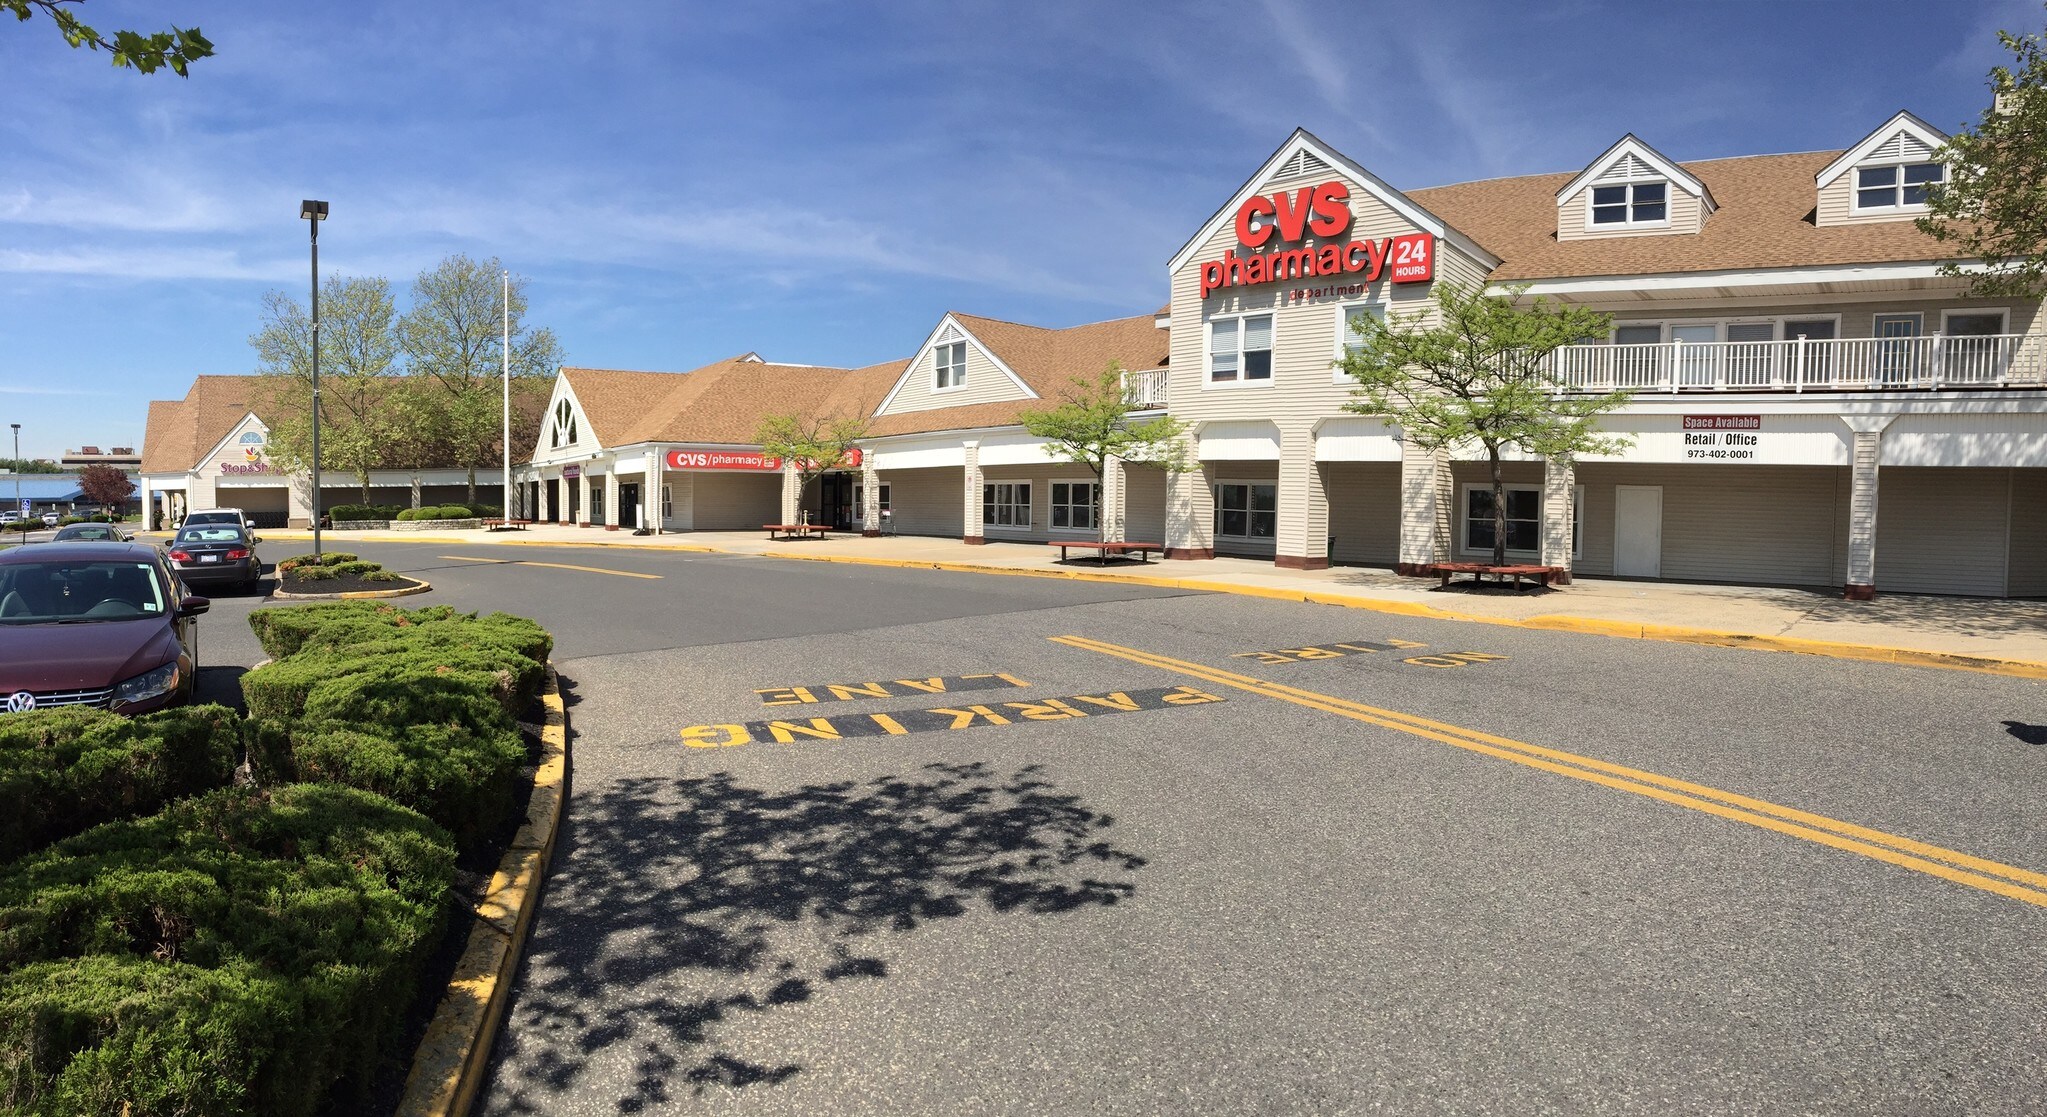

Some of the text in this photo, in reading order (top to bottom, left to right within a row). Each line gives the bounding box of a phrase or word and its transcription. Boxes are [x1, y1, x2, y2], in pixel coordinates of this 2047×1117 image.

[1235, 181, 1350, 247] CVS
[1396, 240, 1427, 264] 24
[1200, 237, 1393, 299] pharmacy
[1396, 265, 1427, 277] HOURS
[1290, 281, 1370, 300] department
[1685, 417, 1759, 428] Space Available
[1685, 433, 1716, 445] Retail
[1726, 433, 1757, 445] Office
[1687, 449, 1754, 459] 973-402-0001
[754, 638, 1430, 706] FIRE LANE
[680, 651, 1512, 749] NO PARKING
